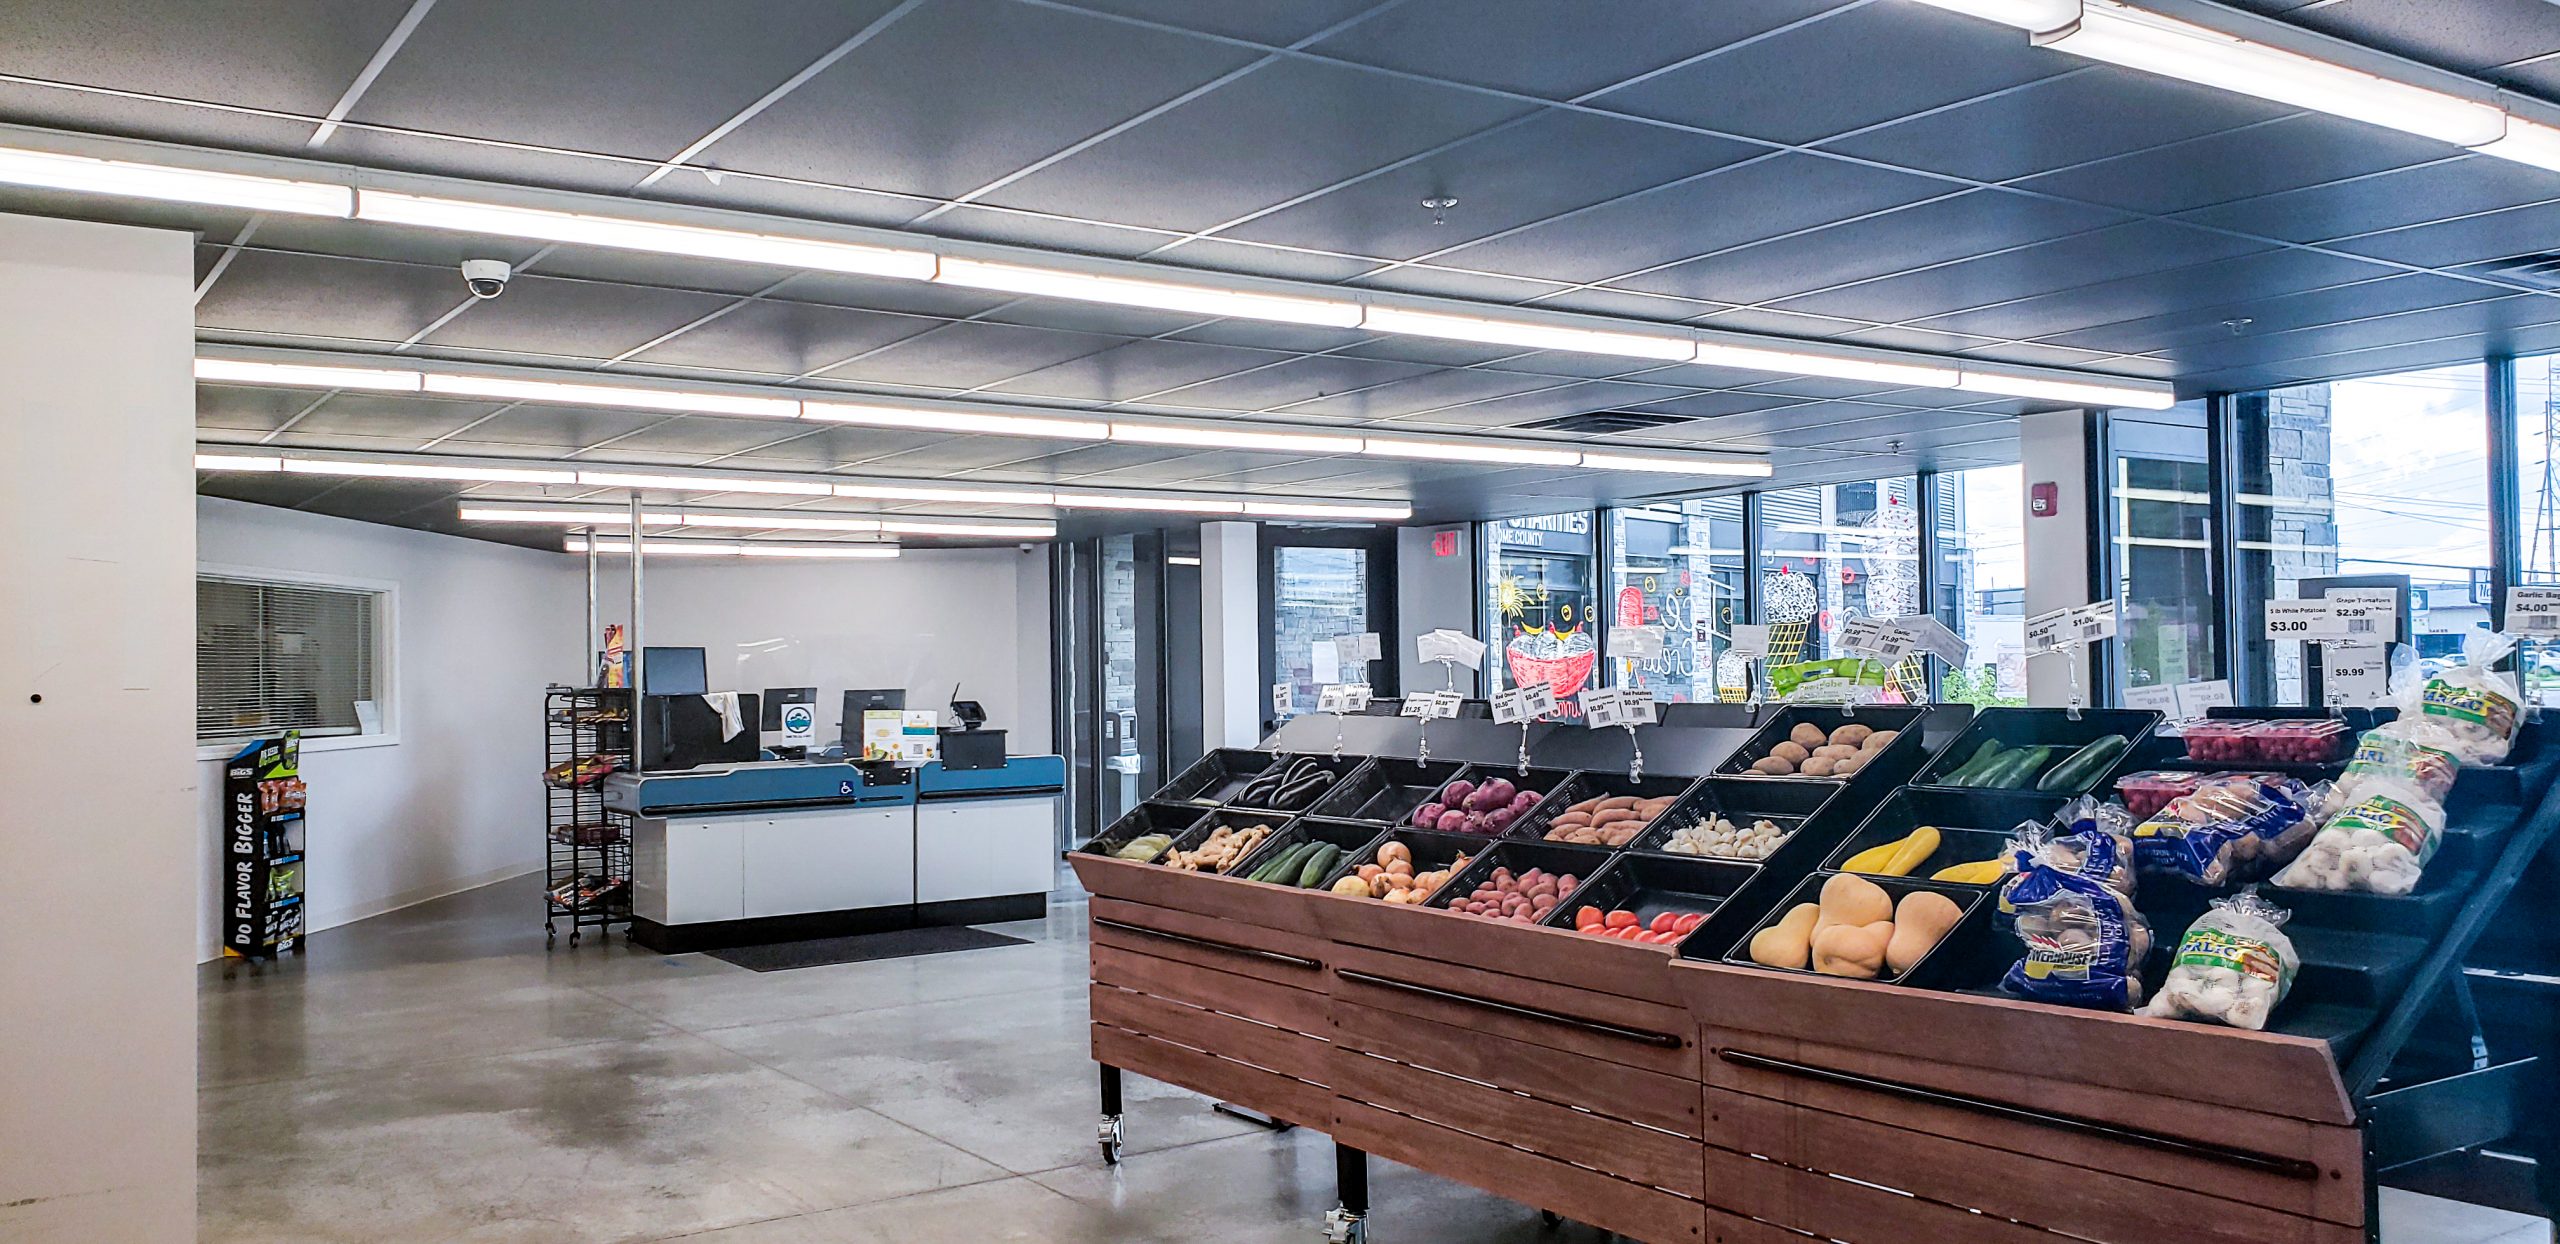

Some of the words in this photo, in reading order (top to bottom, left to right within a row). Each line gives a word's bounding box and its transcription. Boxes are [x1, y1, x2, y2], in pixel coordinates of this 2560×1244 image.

[1436, 532, 1455, 556] EXIT
[1515, 530, 1543, 547] COUNTY
[2336, 608, 2365, 617] $2.99
[2515, 603, 2548, 612] $4.00
[2073, 616, 2094, 627] $1.00
[2270, 621, 2308, 632] $3.00
[1893, 628, 1911, 637] Garlic
[2029, 627, 2049, 639] $0.50
[1880, 634, 1899, 643] $1.99
[2335, 668, 2365, 676] $9.99
[1589, 703, 1604, 712] $0.99
[1624, 698, 1640, 706] $0.99
[233, 792, 254, 854] BIGGER
[235, 861, 254, 919] FLAVOR
[235, 923, 253, 945] DO
